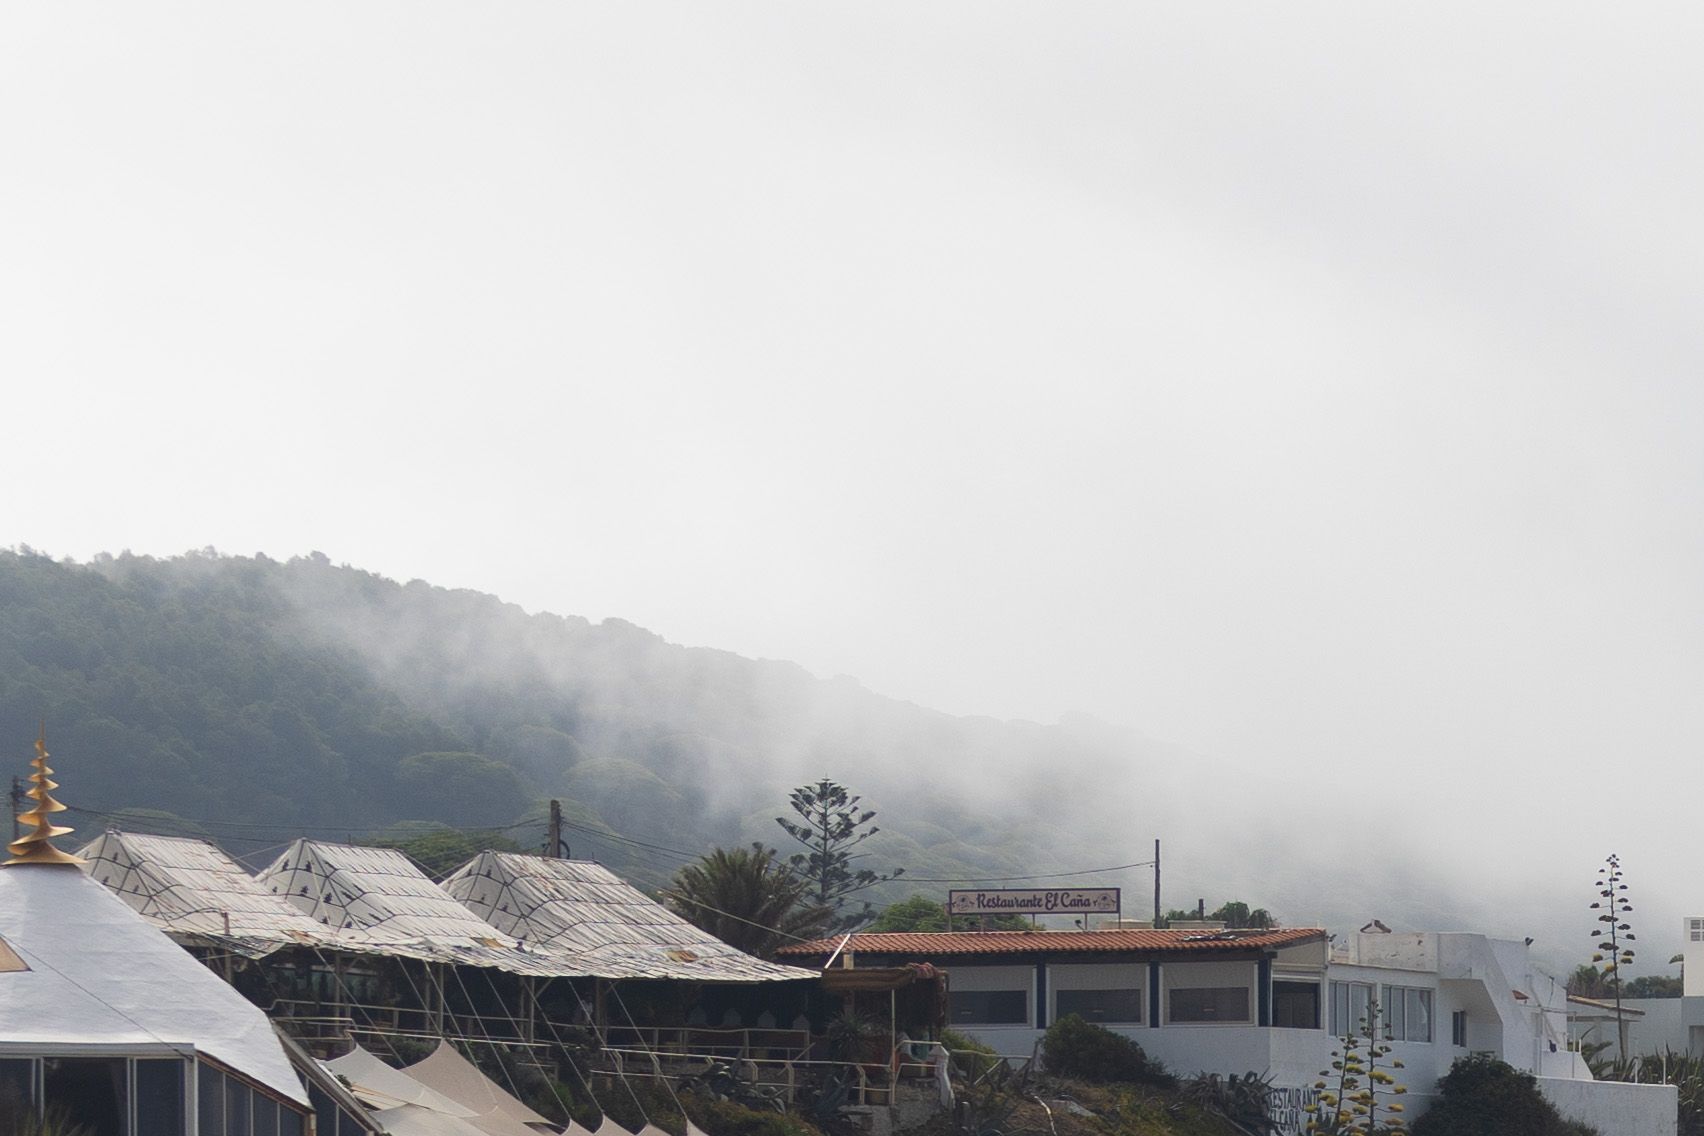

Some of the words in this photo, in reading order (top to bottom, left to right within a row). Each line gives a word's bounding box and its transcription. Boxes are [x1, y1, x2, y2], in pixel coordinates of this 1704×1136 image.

[976, 893, 1042, 908] Restaurante
[1045, 892, 1059, 911] El
[1060, 892, 1091, 908] Caña
